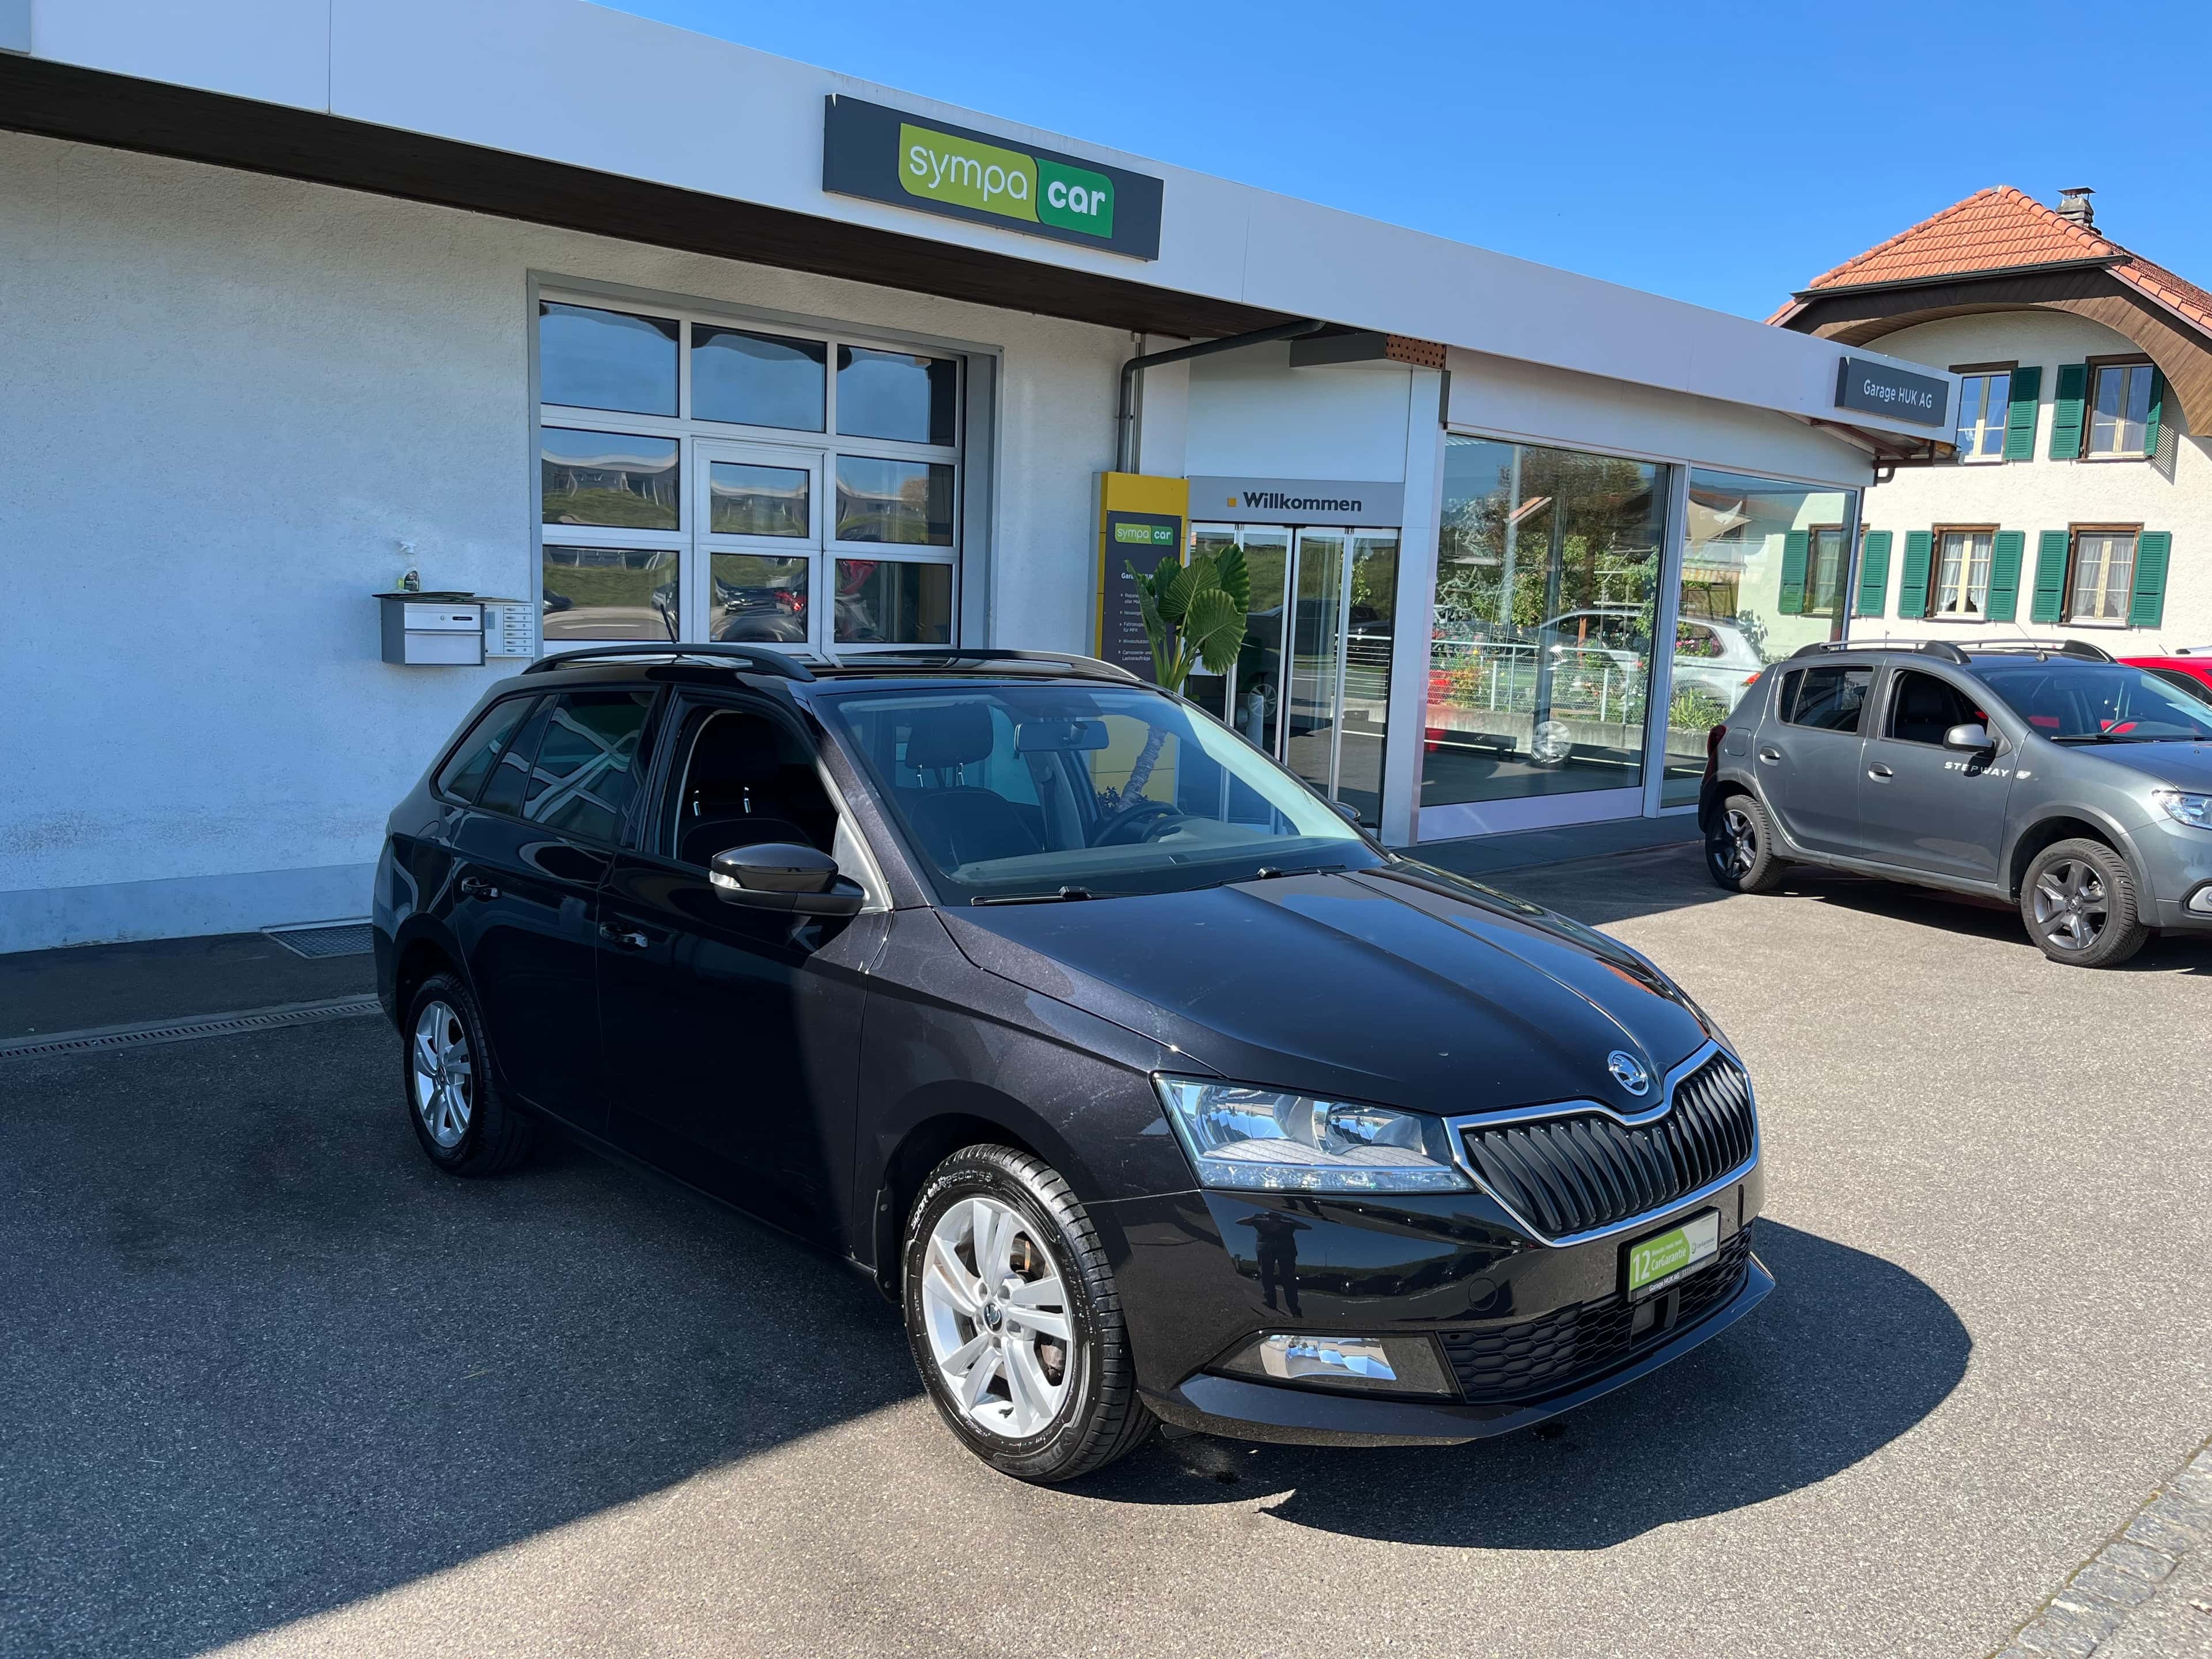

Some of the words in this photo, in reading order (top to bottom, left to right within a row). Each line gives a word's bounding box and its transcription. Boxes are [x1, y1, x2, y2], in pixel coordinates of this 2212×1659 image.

[910, 145, 1028, 202] sympa
[1048, 180, 1105, 217] car
[1863, 379, 1896, 402] Garage
[1898, 387, 1918, 406] HUK
[1919, 392, 1932, 408] AG
[1243, 491, 1362, 512] Willkommen
[1118, 528, 1149, 541] sympa
[1154, 531, 1171, 540] car
[1944, 761, 2010, 777] STEPWAY
[1633, 1249, 1650, 1283] 12
